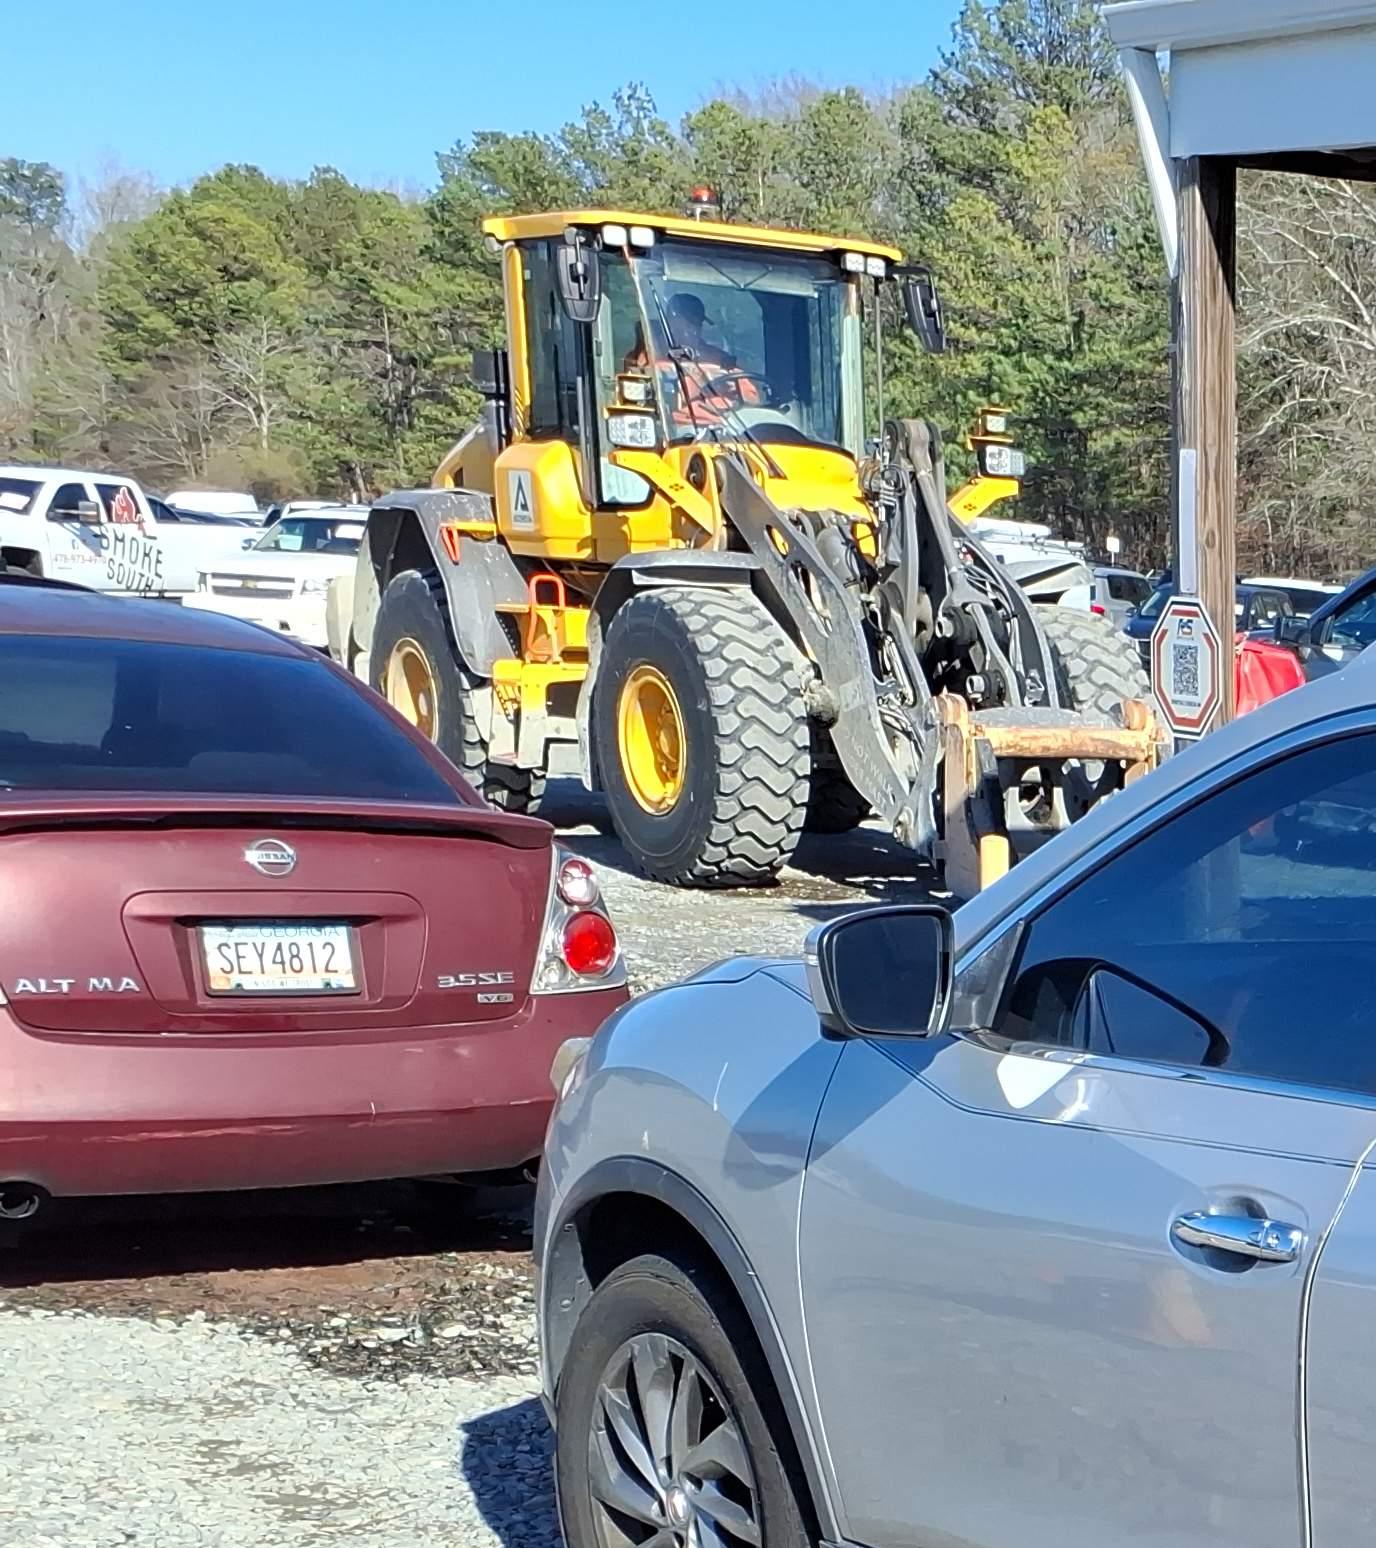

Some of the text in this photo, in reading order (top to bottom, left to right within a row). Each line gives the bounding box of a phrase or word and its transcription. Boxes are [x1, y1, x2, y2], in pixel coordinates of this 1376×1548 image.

[100, 522, 163, 579] SMOKE
[107, 558, 154, 597] SOUTH
[216, 941, 340, 976] SEY4812
